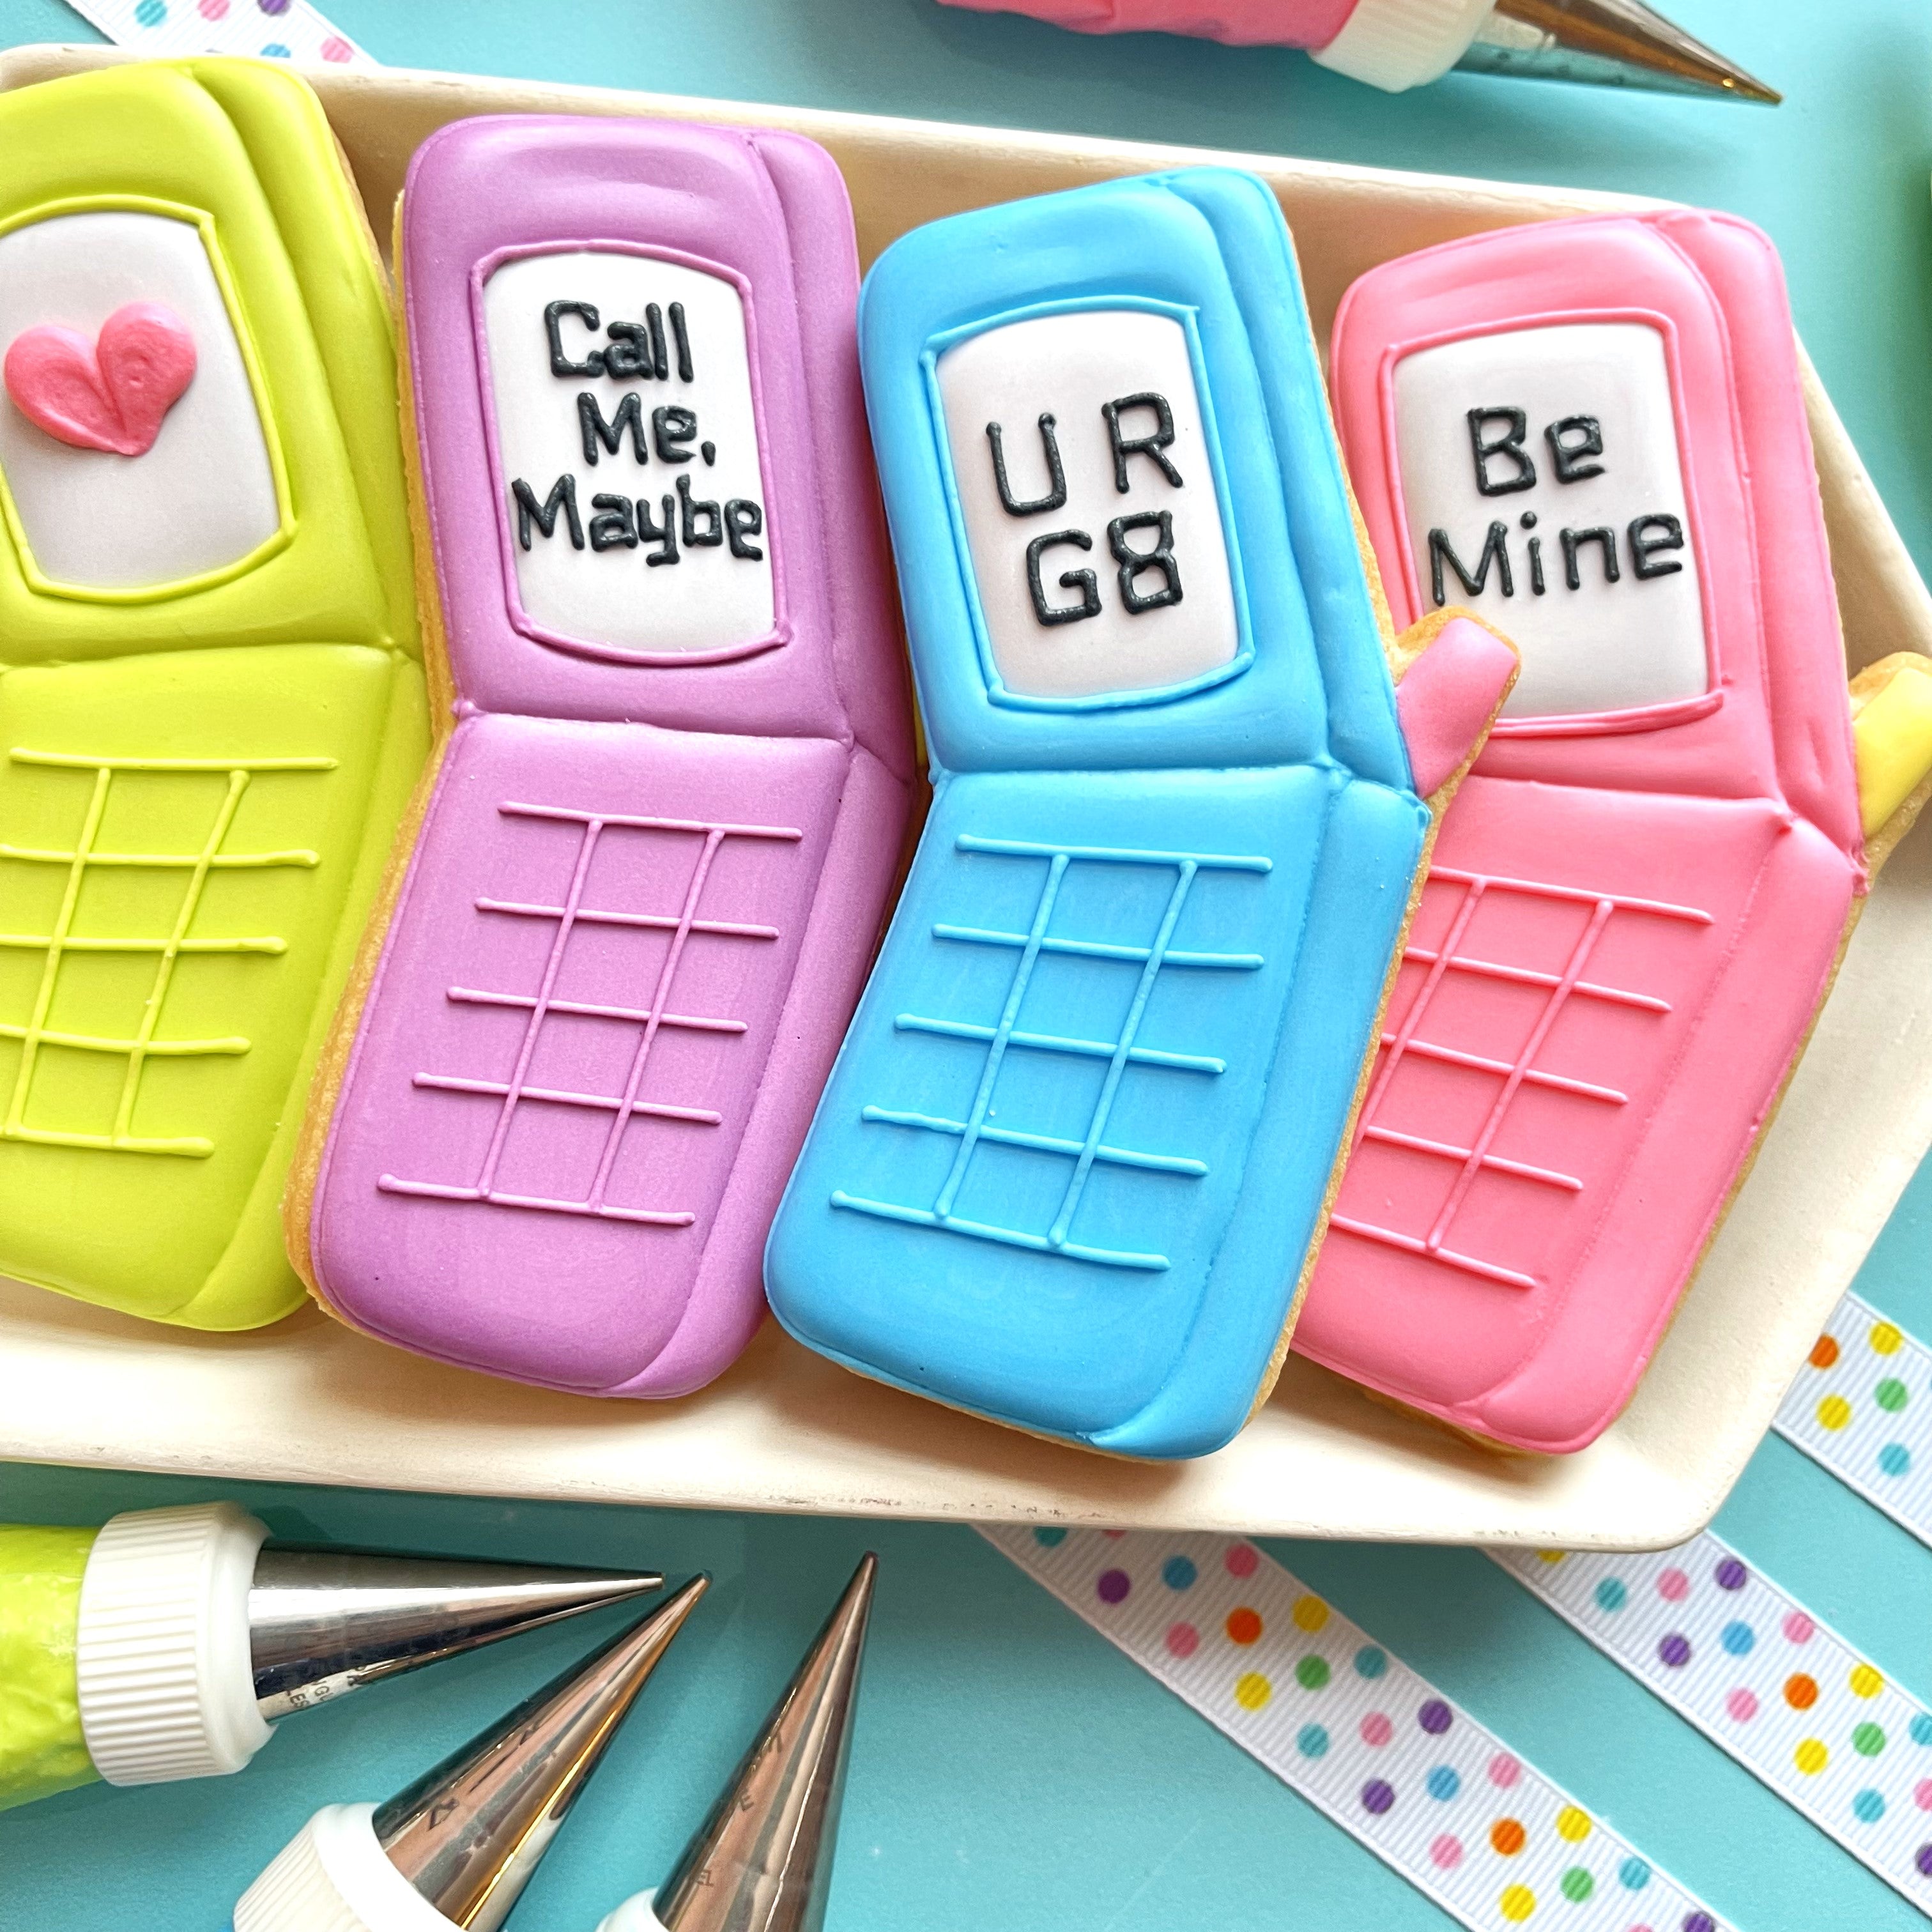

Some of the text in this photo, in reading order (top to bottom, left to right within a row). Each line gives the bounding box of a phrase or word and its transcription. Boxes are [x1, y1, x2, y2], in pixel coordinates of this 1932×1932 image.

[544, 302, 694, 383] Call
[577, 392, 716, 467] Me,
[986, 392, 1183, 518] U R
[1466, 406, 1605, 496] Be
[512, 474, 763, 567] Maybe
[1428, 513, 1684, 606] Mine
[1026, 510, 1183, 625] G8
